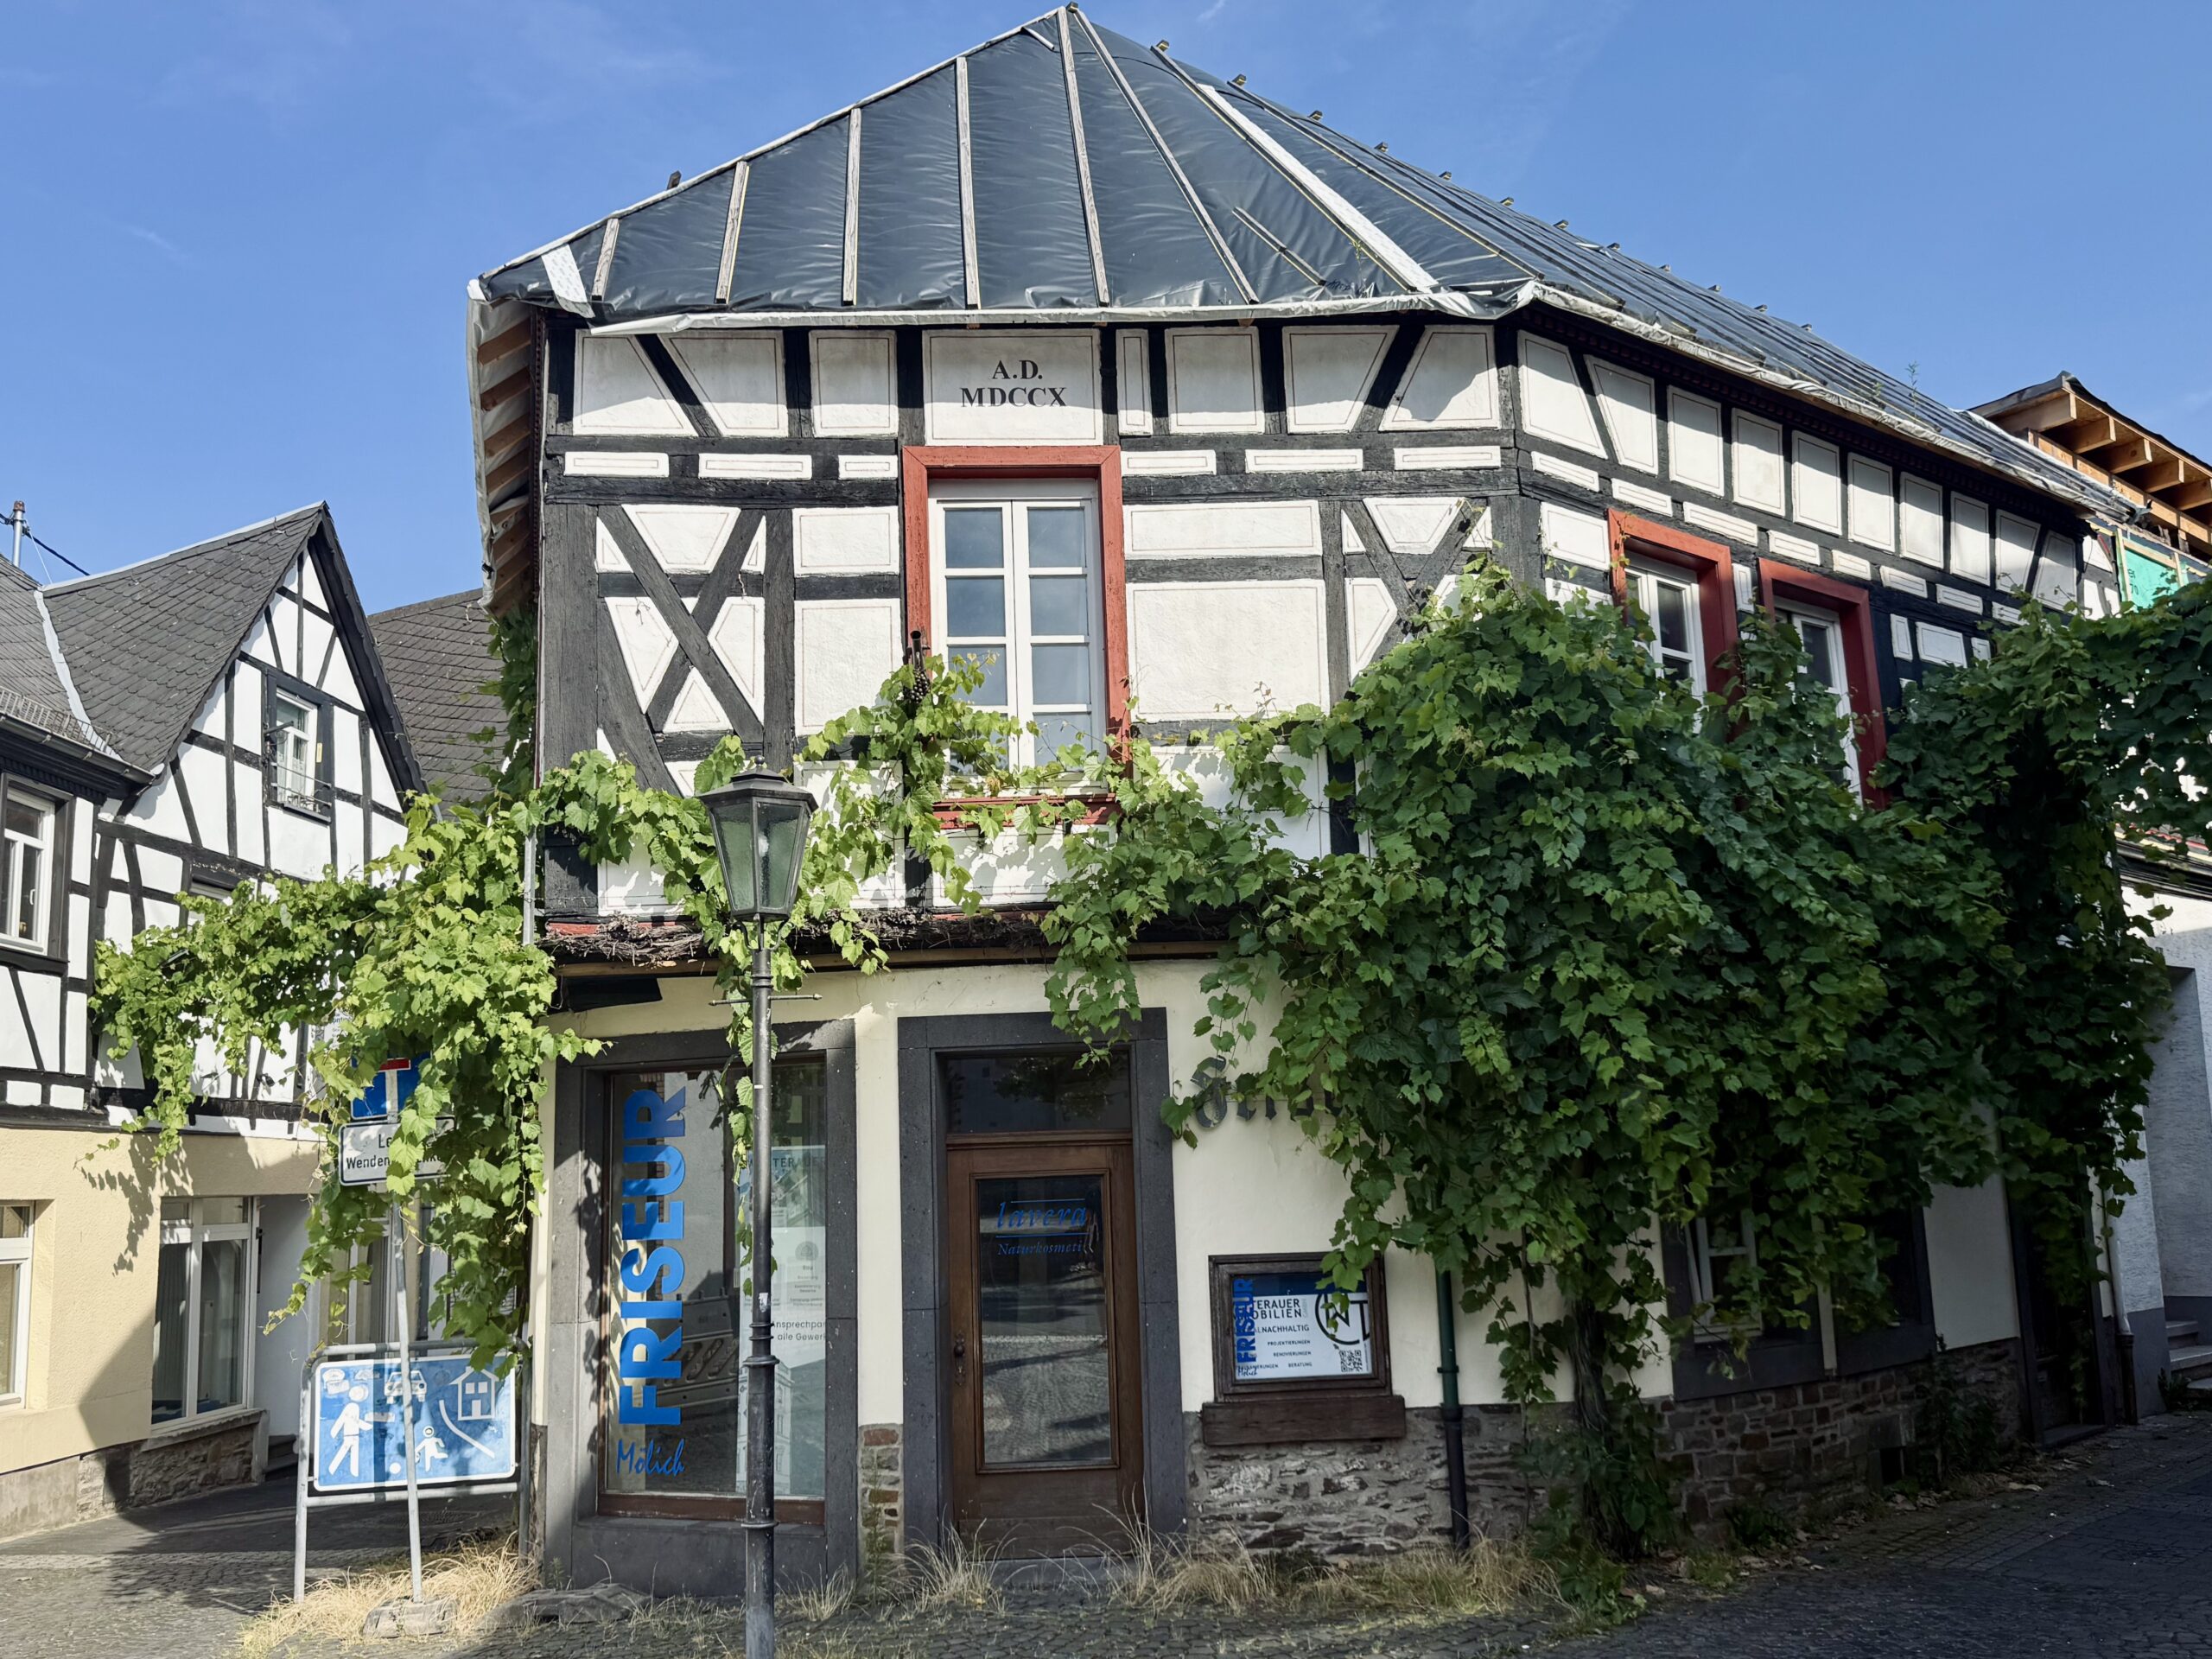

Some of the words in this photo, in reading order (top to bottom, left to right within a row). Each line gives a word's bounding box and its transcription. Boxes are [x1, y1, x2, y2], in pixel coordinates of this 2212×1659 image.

[992, 359, 1043, 379] A.D.
[960, 387, 1067, 407] MDCCX
[996, 1202, 1087, 1229] lavera
[619, 1087, 685, 1425] FRISEUR
[998, 1240, 1084, 1255] Naturkosmeti
[772, 1320, 825, 1330] Ansprechpa
[616, 1438, 685, 1478] Mölich
